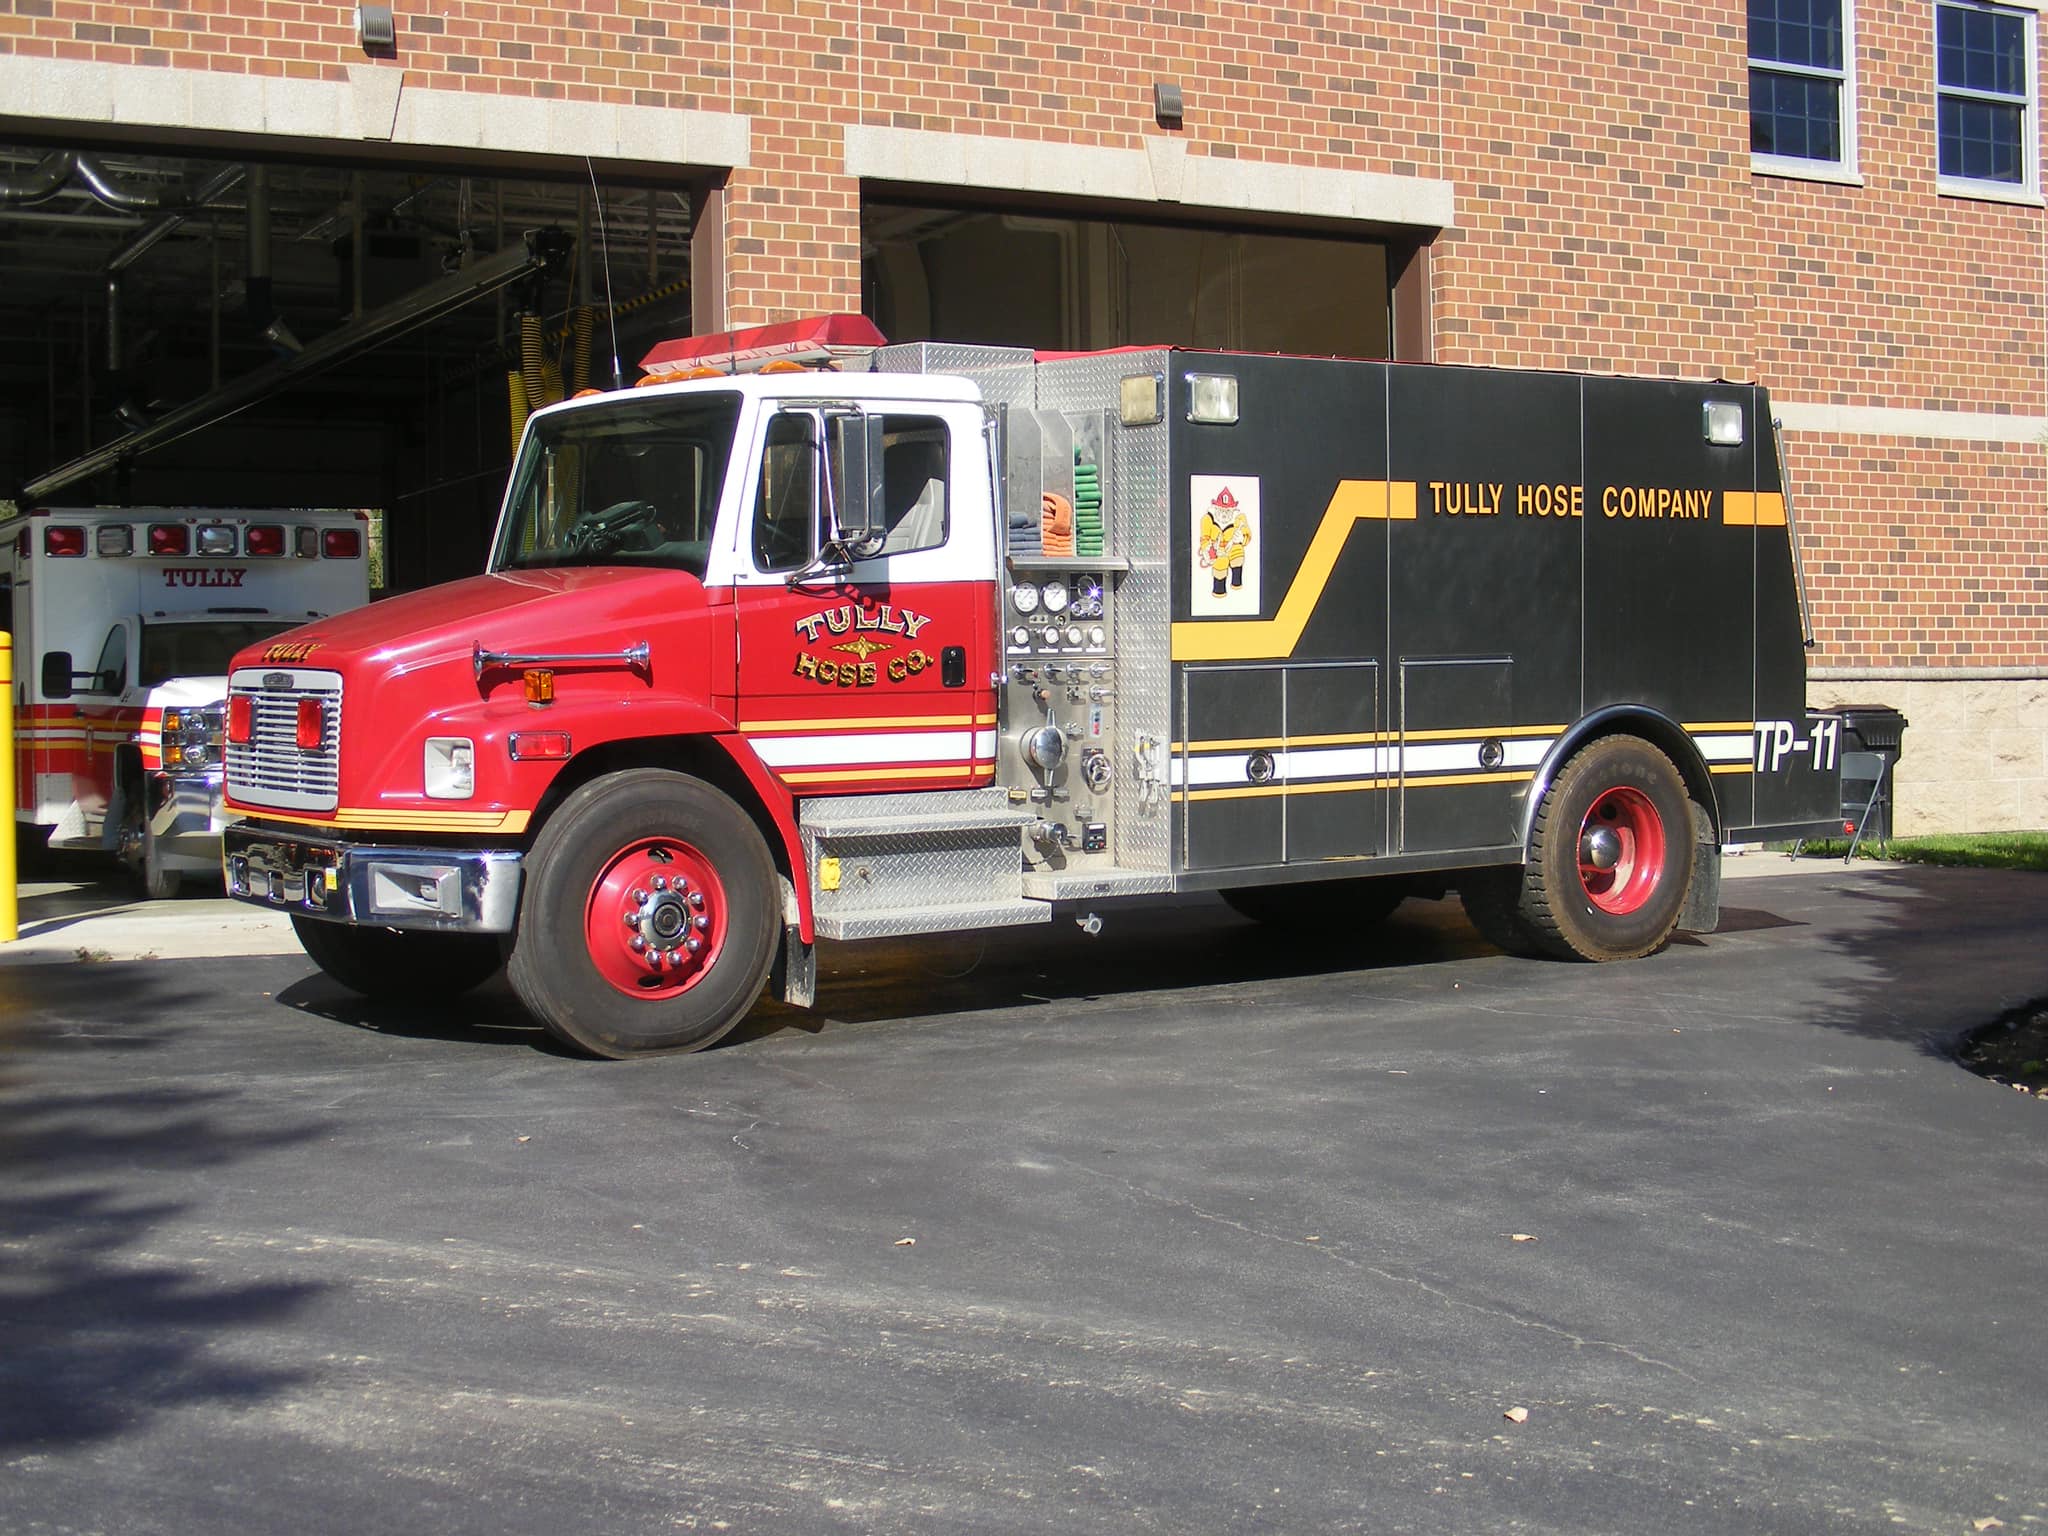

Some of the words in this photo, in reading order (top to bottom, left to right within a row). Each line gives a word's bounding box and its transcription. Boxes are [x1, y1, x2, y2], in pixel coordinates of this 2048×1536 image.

[1429, 481, 1504, 515] TULLY
[1517, 484, 1583, 517] HOSE
[1602, 486, 1713, 519] COMPANY
[162, 568, 248, 588] TULLY
[796, 604, 931, 644] TULLY
[262, 643, 326, 663] TULLY
[793, 651, 878, 687] HOSE
[1754, 719, 1839, 773] TP-11
